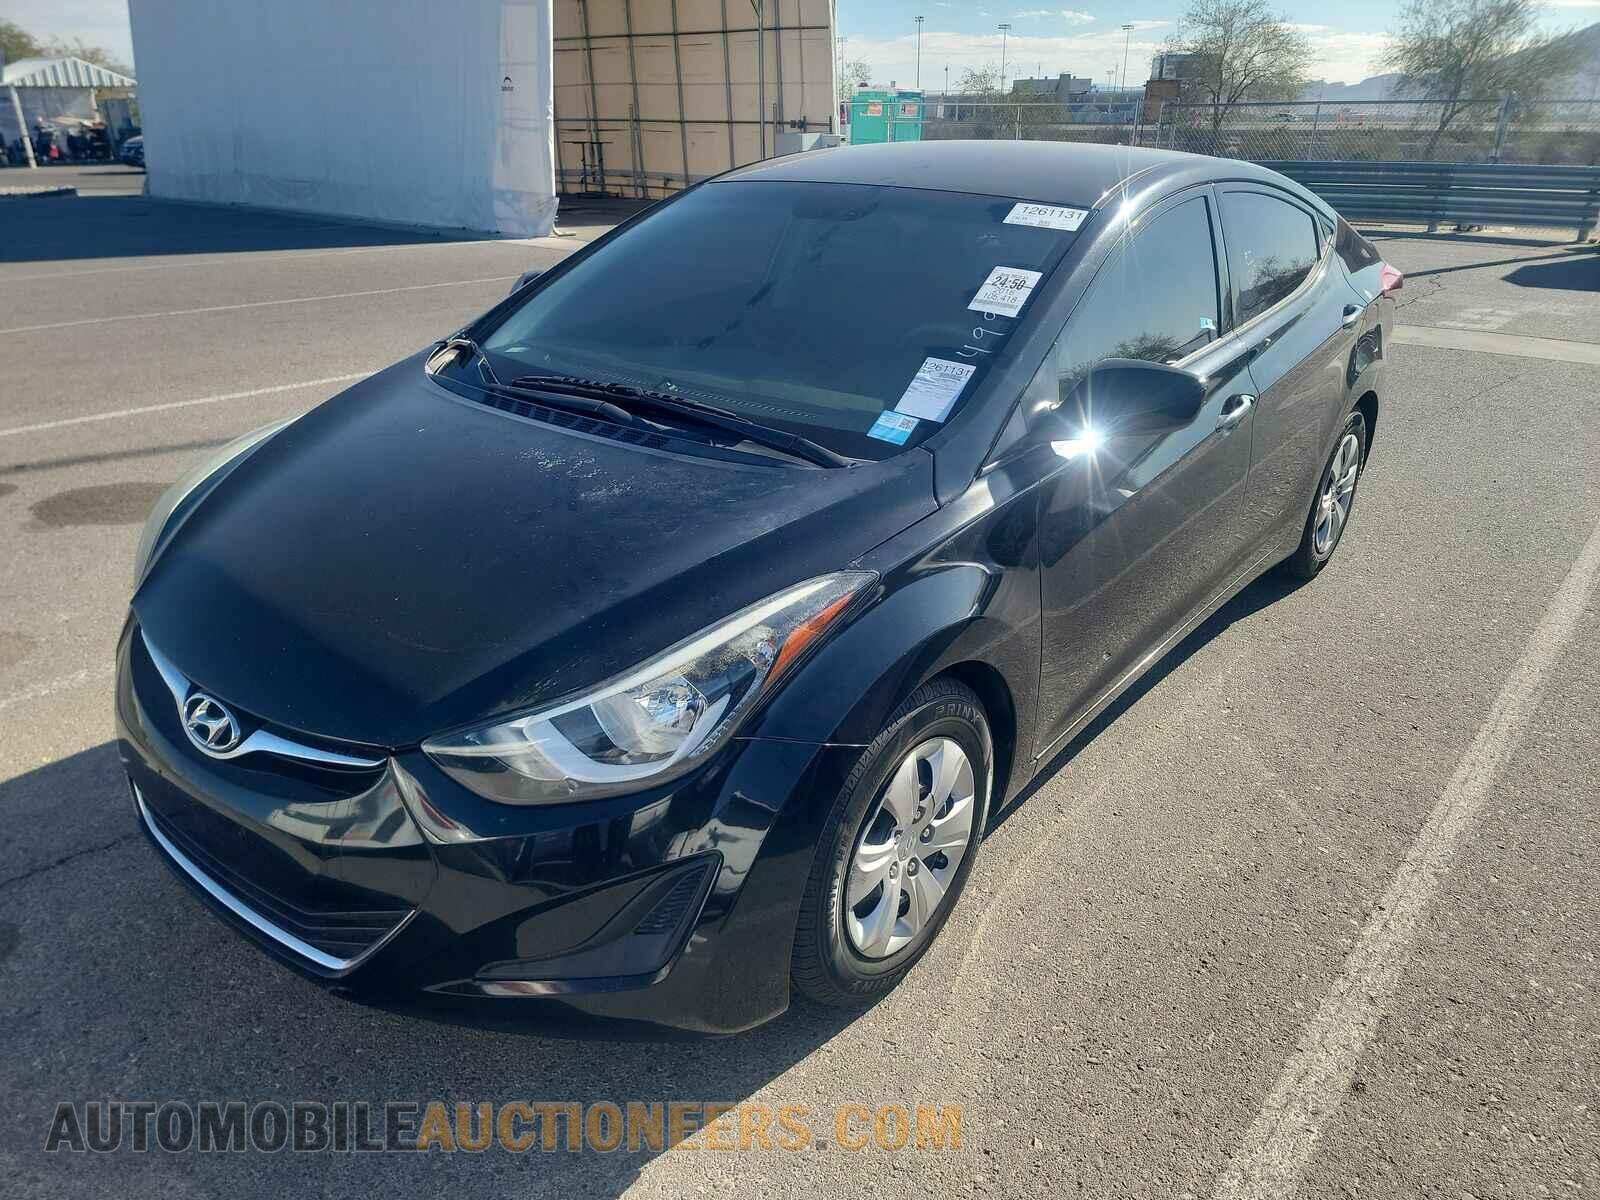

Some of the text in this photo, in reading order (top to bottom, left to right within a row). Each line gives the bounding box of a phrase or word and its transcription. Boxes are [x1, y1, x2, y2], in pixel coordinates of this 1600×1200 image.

[1022, 206, 1083, 220] 1261131
[991, 275, 1026, 290] 24:50
[923, 361, 971, 377] 1261131
